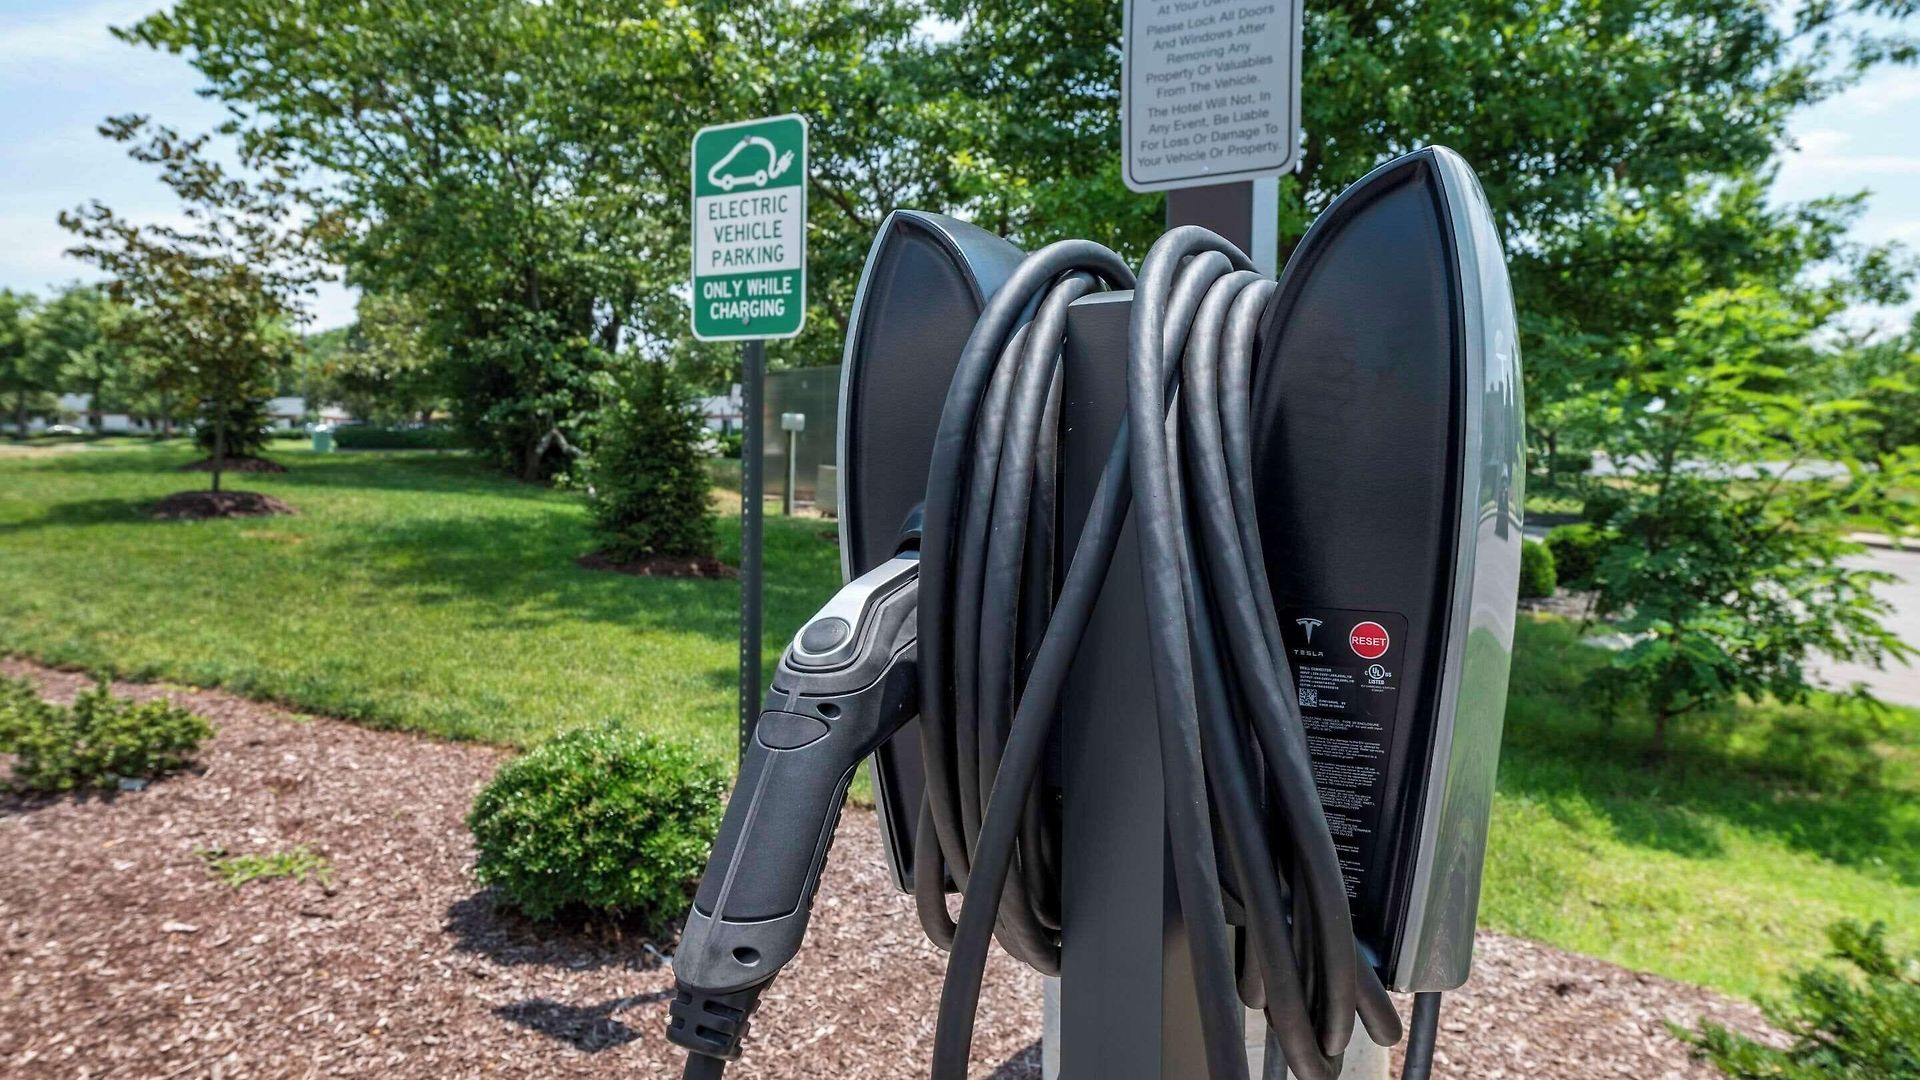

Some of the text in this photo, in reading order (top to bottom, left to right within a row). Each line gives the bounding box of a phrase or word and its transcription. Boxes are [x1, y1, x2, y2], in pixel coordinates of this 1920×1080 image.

[1146, 5, 1275, 36] Please Lock All Doors
[1158, 6, 1171, 16] At
[1175, 2, 1198, 13] Your
[1153, 23, 1266, 51] And Windows After
[1167, 42, 1252, 64] Removing Any
[1146, 55, 1273, 84] Property Or Valuables
[1157, 75, 1261, 99] From The Vehicle.
[1148, 107, 1168, 118] The
[1172, 102, 1202, 115] Hotel
[1206, 97, 1227, 109] Will
[1260, 92, 1271, 101] In
[1148, 108, 1270, 135] Any Event, Be Liable
[1141, 122, 1278, 152] For Loss Or Damage To
[1138, 141, 1282, 167] Your Vehicle Or Property.
[709, 195, 788, 220] ELECTRIC
[714, 220, 782, 243] VEHICLE
[712, 245, 784, 268] PARKING
[703, 276, 792, 300] ONLY WHILE
[710, 299, 785, 320] CHARGING
[1294, 649, 1324, 657] TESLA
[1352, 636, 1386, 647] RESET
